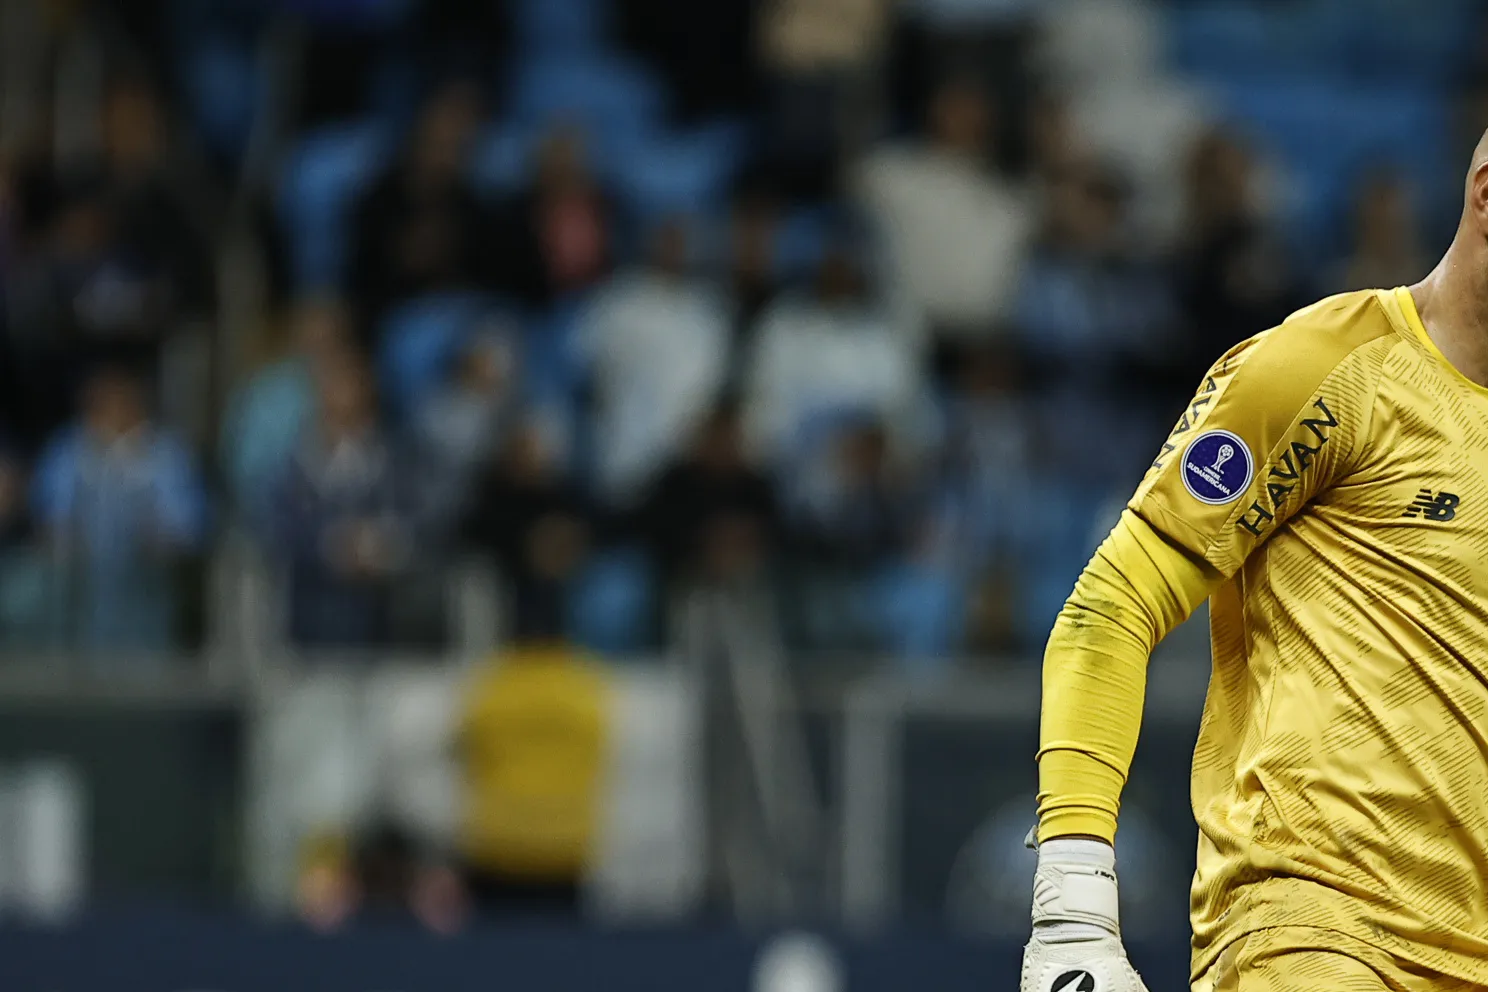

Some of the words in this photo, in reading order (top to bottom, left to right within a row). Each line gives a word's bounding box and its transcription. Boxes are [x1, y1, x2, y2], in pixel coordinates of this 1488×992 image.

[1152, 356, 1232, 470] AVAN
[1236, 397, 1338, 538] HAVAN
[1187, 462, 1231, 496] SUDAMERICANA
